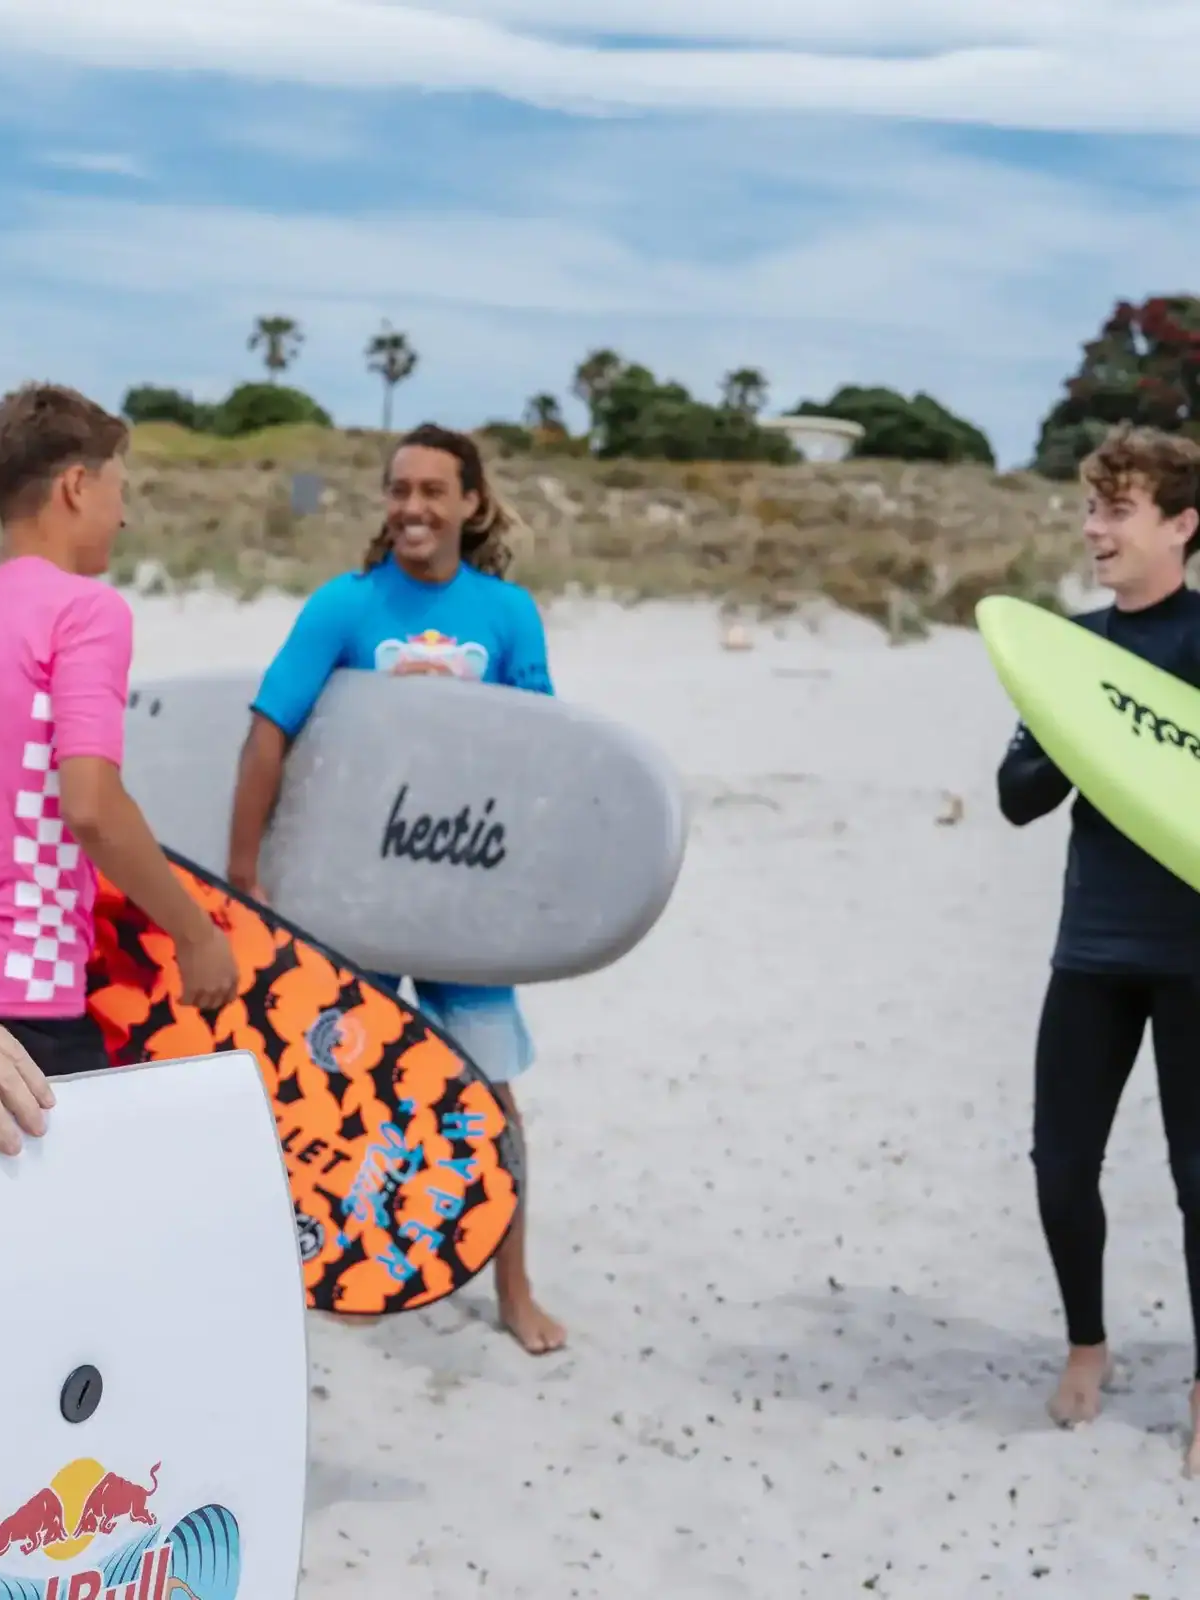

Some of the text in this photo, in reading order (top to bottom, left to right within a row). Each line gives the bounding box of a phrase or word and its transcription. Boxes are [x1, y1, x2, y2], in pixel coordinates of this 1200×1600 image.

[380, 782, 507, 870] hectic
[279, 1126, 352, 1175] LET
[375, 1111, 487, 1281] HYPER
